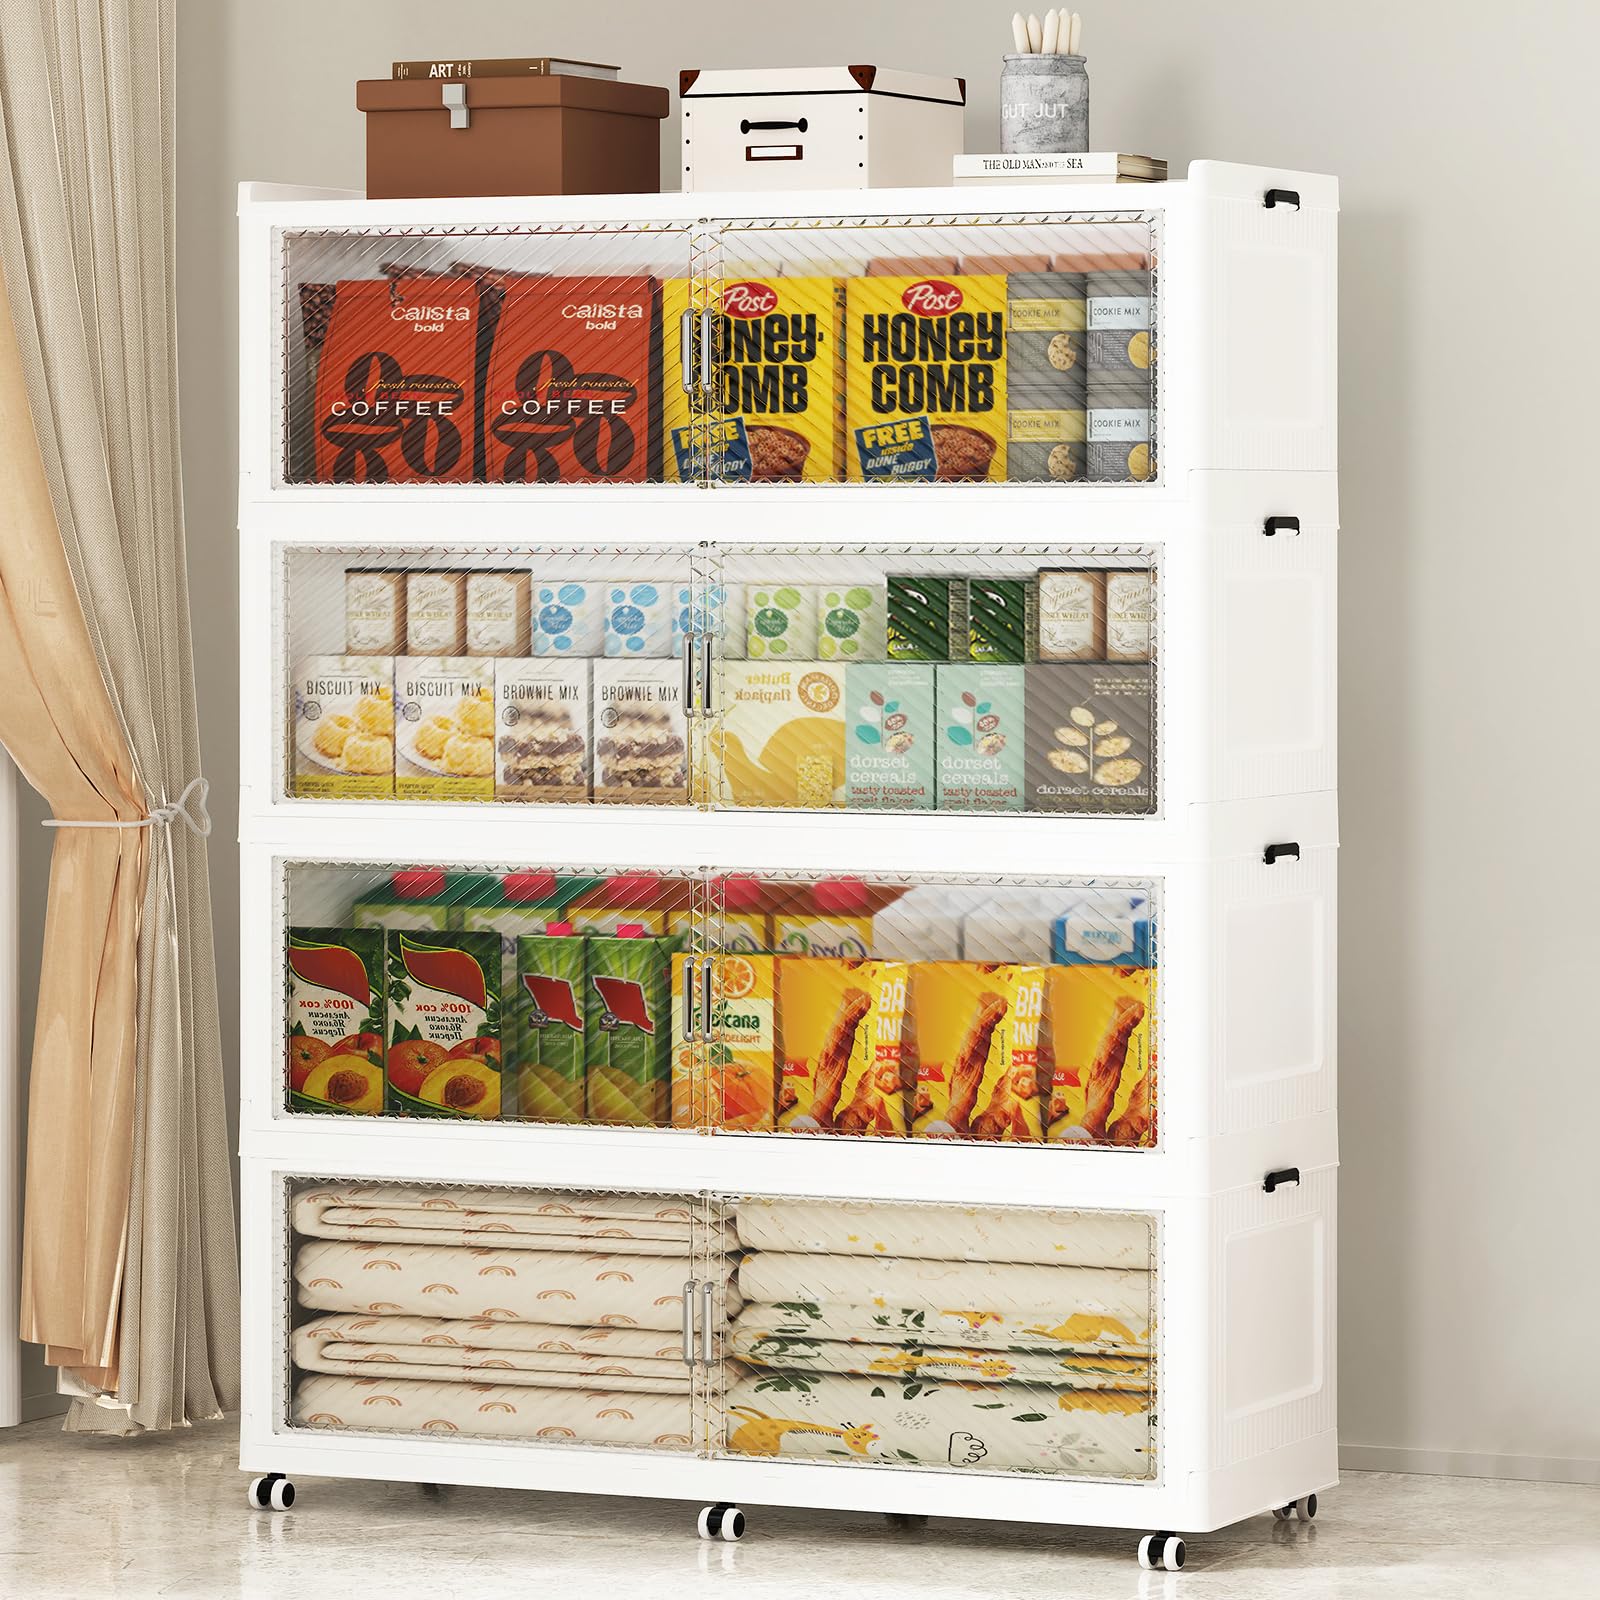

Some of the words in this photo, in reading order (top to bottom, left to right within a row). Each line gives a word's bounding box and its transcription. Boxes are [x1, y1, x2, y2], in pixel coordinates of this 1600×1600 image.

[429, 63, 454, 78] ART
[1034, 103, 1069, 118] JUT
[983, 159, 1001, 170] THE
[1002, 159, 1021, 169] OLD
[1022, 158, 1042, 169] MAN
[1066, 158, 1083, 169] SEA
[722, 286, 775, 312] Post
[906, 284, 960, 311] Post
[1093, 307, 1122, 316] COOKIE
[1124, 307, 1140, 316] MIX
[413, 322, 445, 333] bold
[585, 320, 617, 331] bold
[362, 379, 406, 392] fresh
[409, 379, 466, 390] roasted
[532, 377, 577, 391] fresh
[581, 378, 640, 389] roasted
[871, 363, 995, 414] COMB
[331, 400, 454, 417] COFFEE
[501, 399, 627, 416] COFFEE
[1013, 419, 1041, 429] COOKIE
[1044, 419, 1060, 428] MIX
[1093, 419, 1122, 428] COOKIE
[1124, 419, 1141, 428] MIX
[862, 420, 925, 449] FREE
[865, 453, 901, 470] DUNE
[306, 680, 354, 696] BISCUIT
[360, 680, 382, 696] MIX
[406, 681, 455, 697] BISCUIT
[461, 681, 483, 697] MIX
[503, 684, 554, 701] BROWNIE
[559, 685, 579, 701] MIX
[602, 685, 653, 702] BROWNIE
[658, 686, 679, 702] MIX
[850, 754, 910, 769] dorset
[942, 756, 1002, 770] dorset
[850, 769, 917, 784] cereals
[942, 770, 1009, 785] cereals
[851, 786, 880, 798] tasty
[882, 785, 925, 796] toasted
[943, 787, 972, 798] tasty
[974, 787, 1017, 797] toasted
[1036, 783, 1090, 795] dorset
[725, 1033, 761, 1043] DELIGHT
